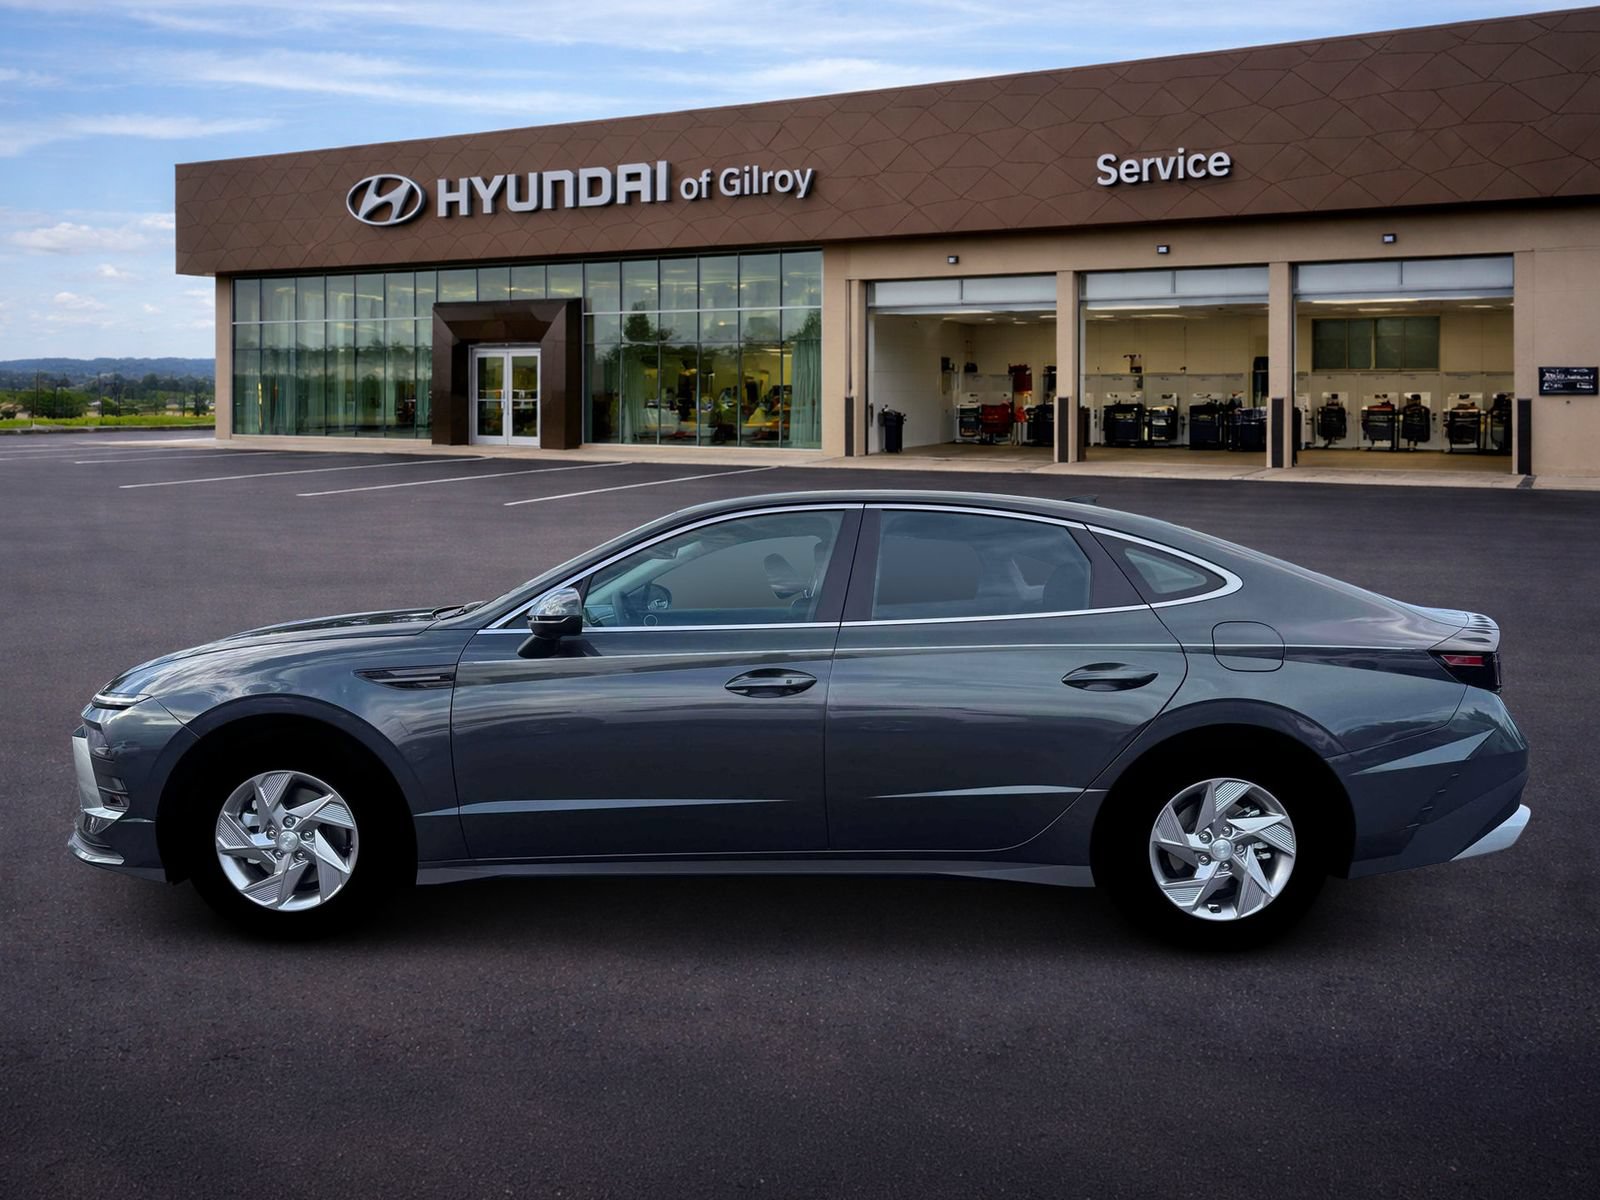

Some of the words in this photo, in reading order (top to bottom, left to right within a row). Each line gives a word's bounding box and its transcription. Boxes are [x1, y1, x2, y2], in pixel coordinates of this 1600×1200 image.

[436, 160, 668, 218] HYUNDAI
[680, 169, 711, 201] of
[718, 164, 814, 199] Gilroy
[1096, 147, 1231, 186] Service
